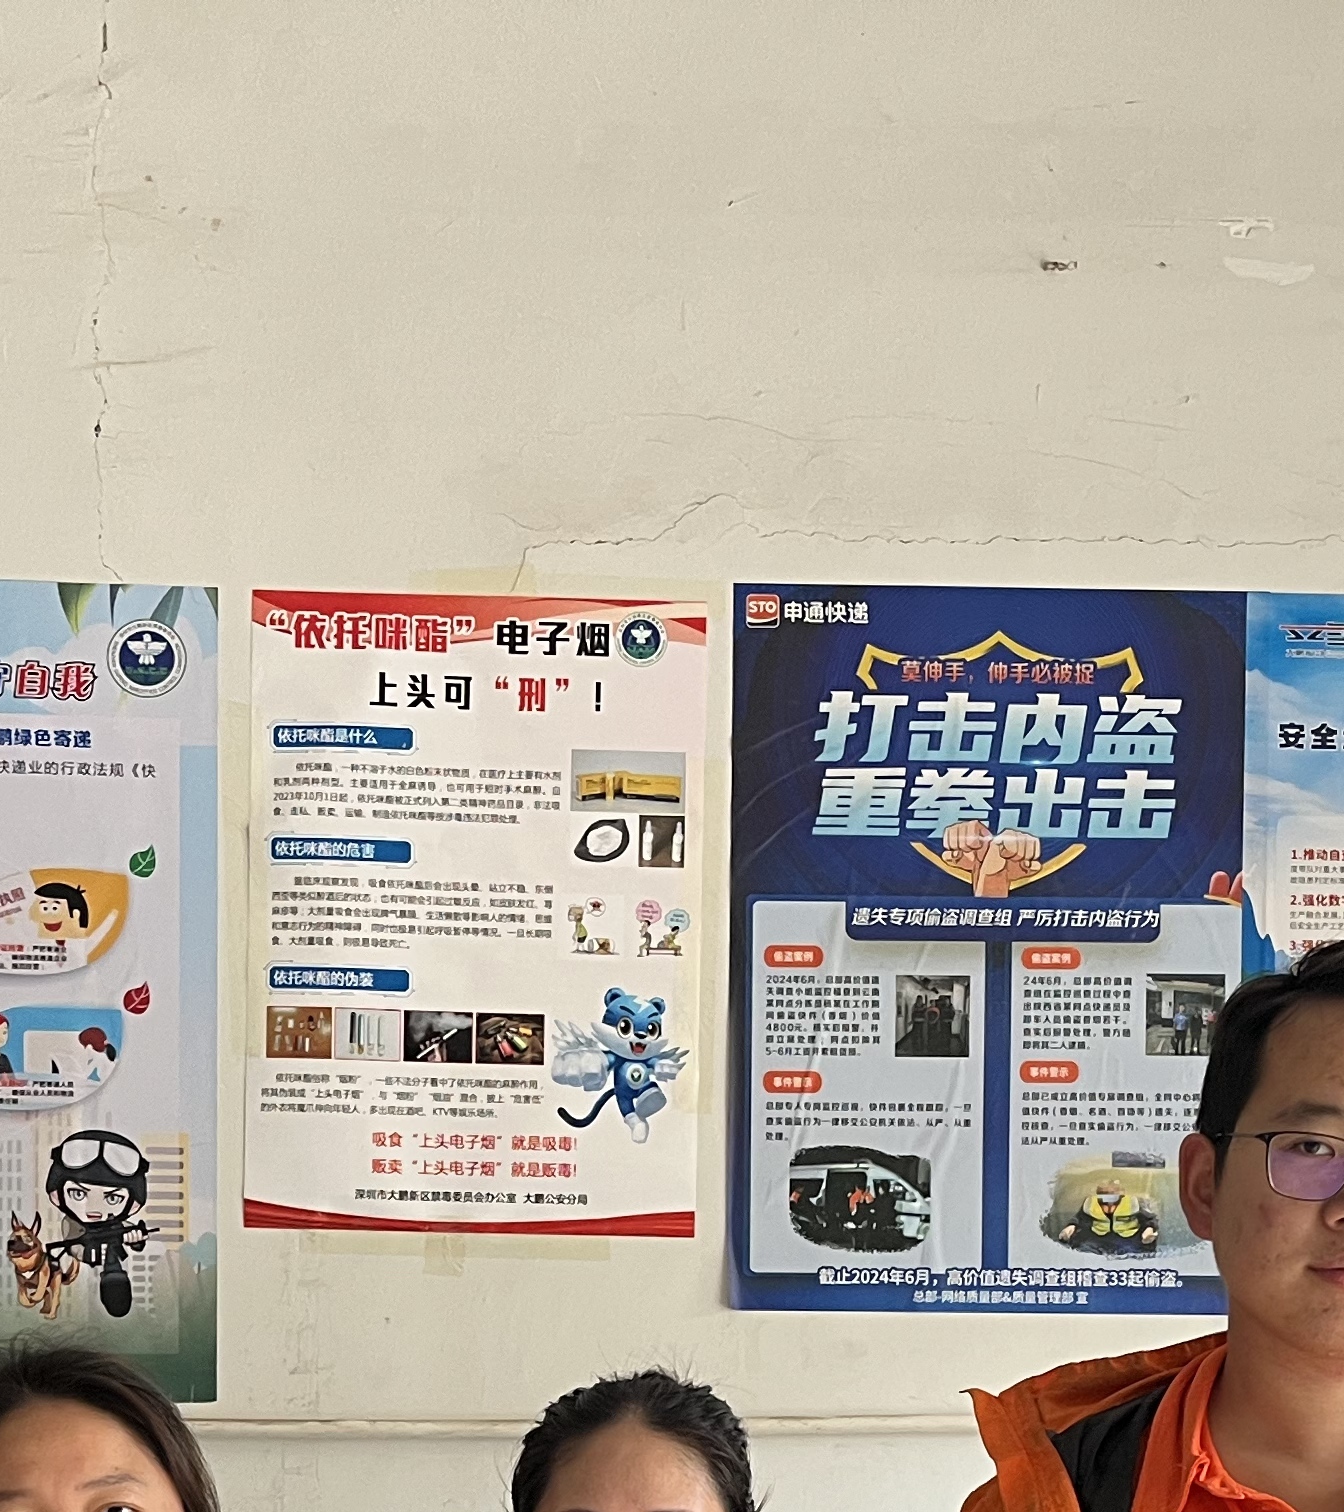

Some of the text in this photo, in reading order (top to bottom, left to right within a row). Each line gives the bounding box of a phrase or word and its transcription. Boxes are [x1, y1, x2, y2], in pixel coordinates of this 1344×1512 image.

[748, 600, 777, 614] STO
[784, 601, 869, 624] 申通快递
[900, 660, 1096, 686] 莫伸手，伸手必被捉
[277, 727, 378, 745] 依托咪酯是什么
[814, 690, 1183, 764] 打击内盗
[811, 767, 1177, 839] 重拳出击
[275, 840, 376, 859] 依托咪酯的危害
[851, 906, 1160, 929] 遗失专项偷盗调查组 严厉打击内盗行为
[273, 970, 374, 987] 依托咪酯的伪装
